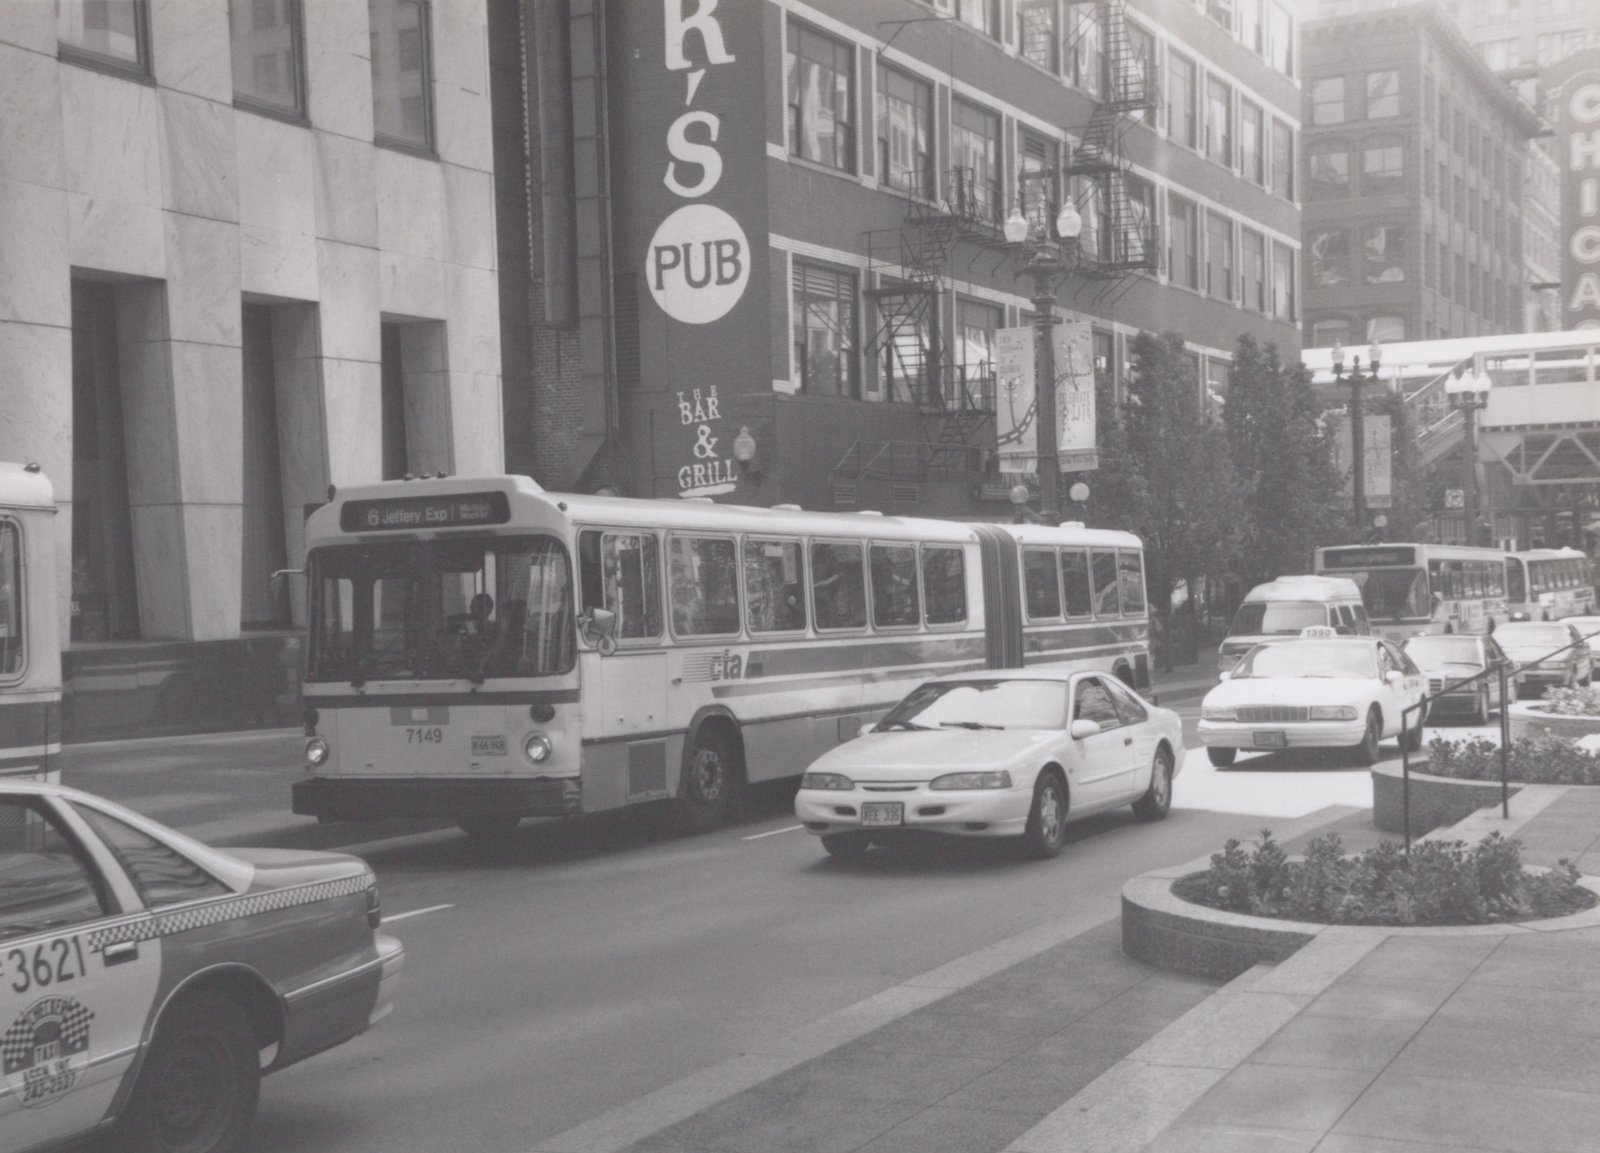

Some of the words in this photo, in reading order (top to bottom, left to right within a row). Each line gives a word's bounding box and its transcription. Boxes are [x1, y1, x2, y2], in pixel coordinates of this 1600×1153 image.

[1569, 83, 1600, 331] CHICA
[654, 239, 742, 290] PUB
[677, 385, 718, 402] THE
[678, 397, 722, 425] BAR
[693, 425, 719, 458] &
[678, 459, 738, 488] GRILL
[367, 509, 379, 526] 6
[382, 510, 421, 525] Jeffery
[426, 506, 448, 522] Exp
[406, 727, 443, 744] 7149
